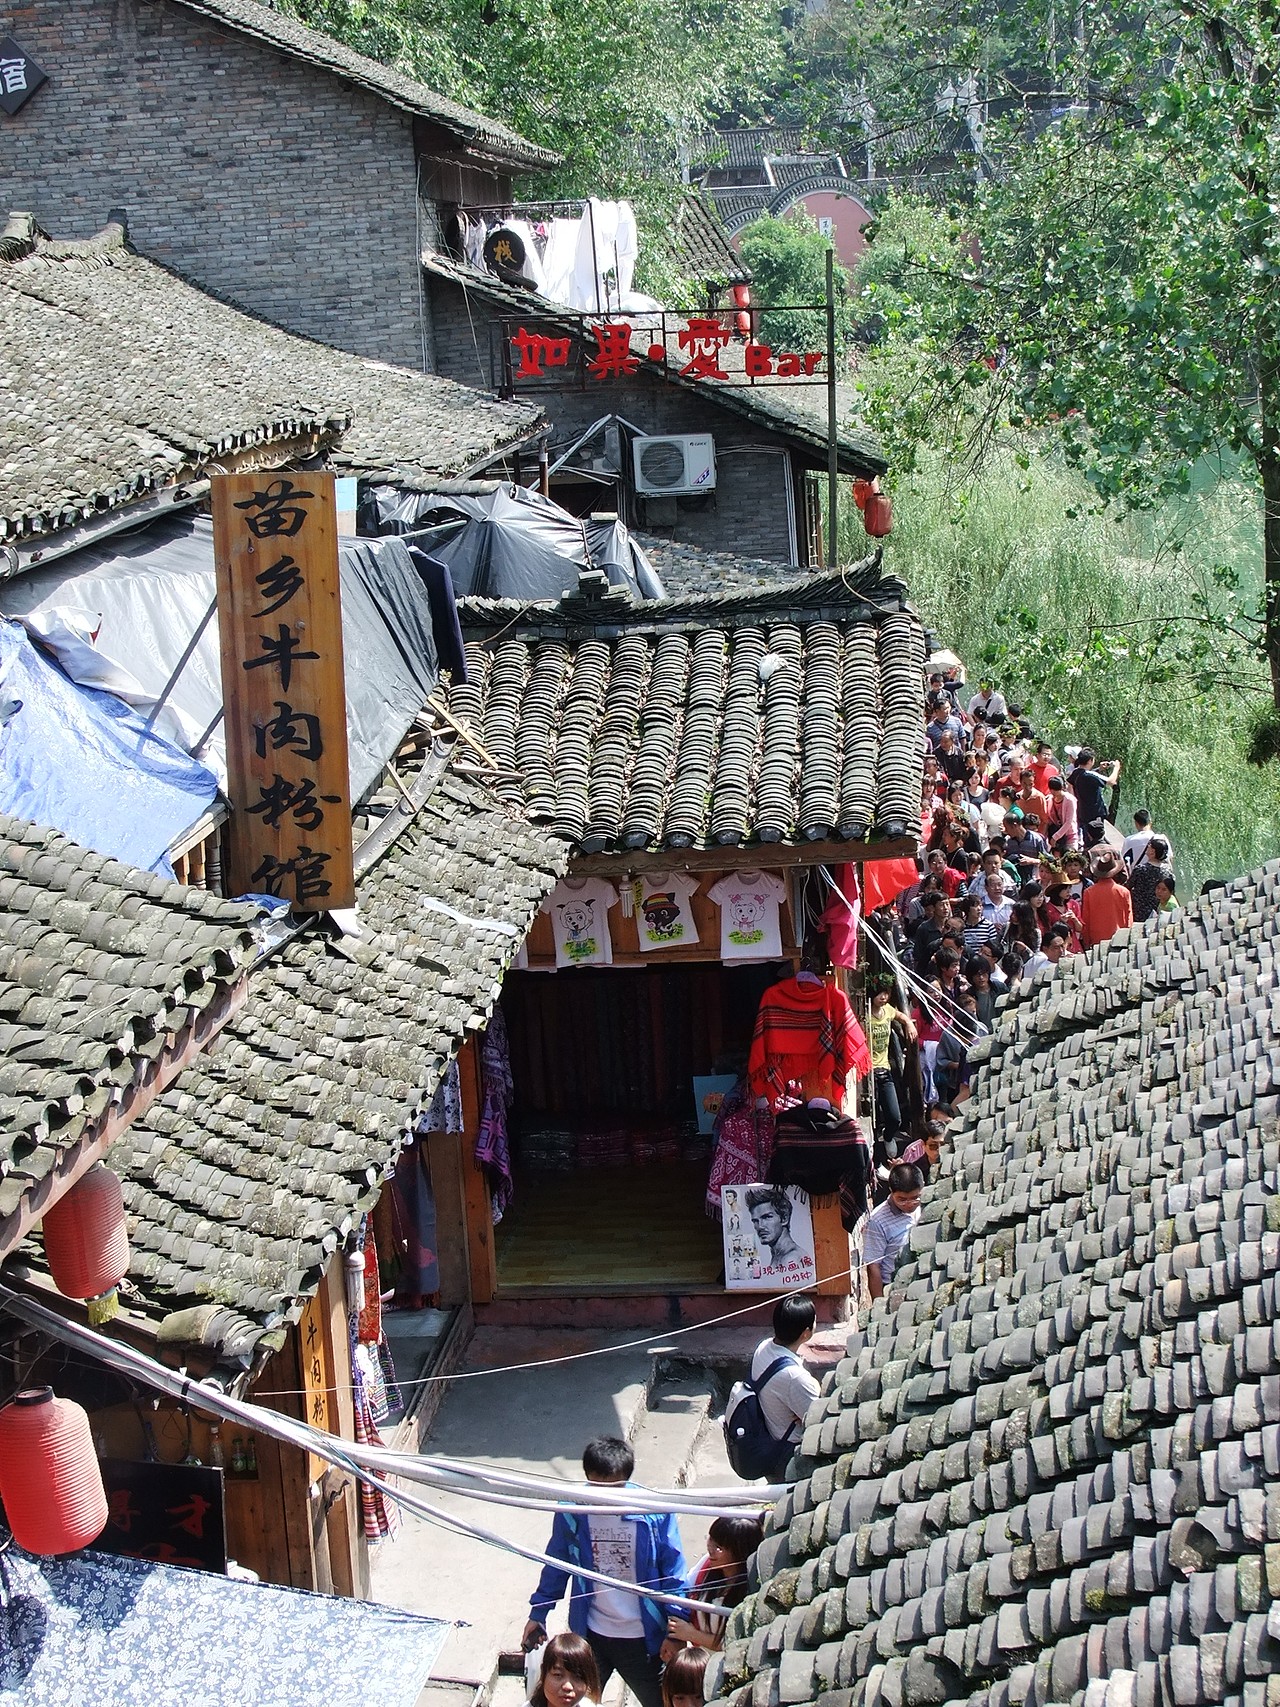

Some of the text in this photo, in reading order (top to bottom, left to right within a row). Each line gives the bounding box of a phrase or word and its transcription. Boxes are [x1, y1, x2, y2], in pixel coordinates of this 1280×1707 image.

[744, 346, 822, 377] Bar
[233, 480, 342, 906] 苗乡牛肉粉馆
[305, 1298, 326, 1440] 牛肉粉
